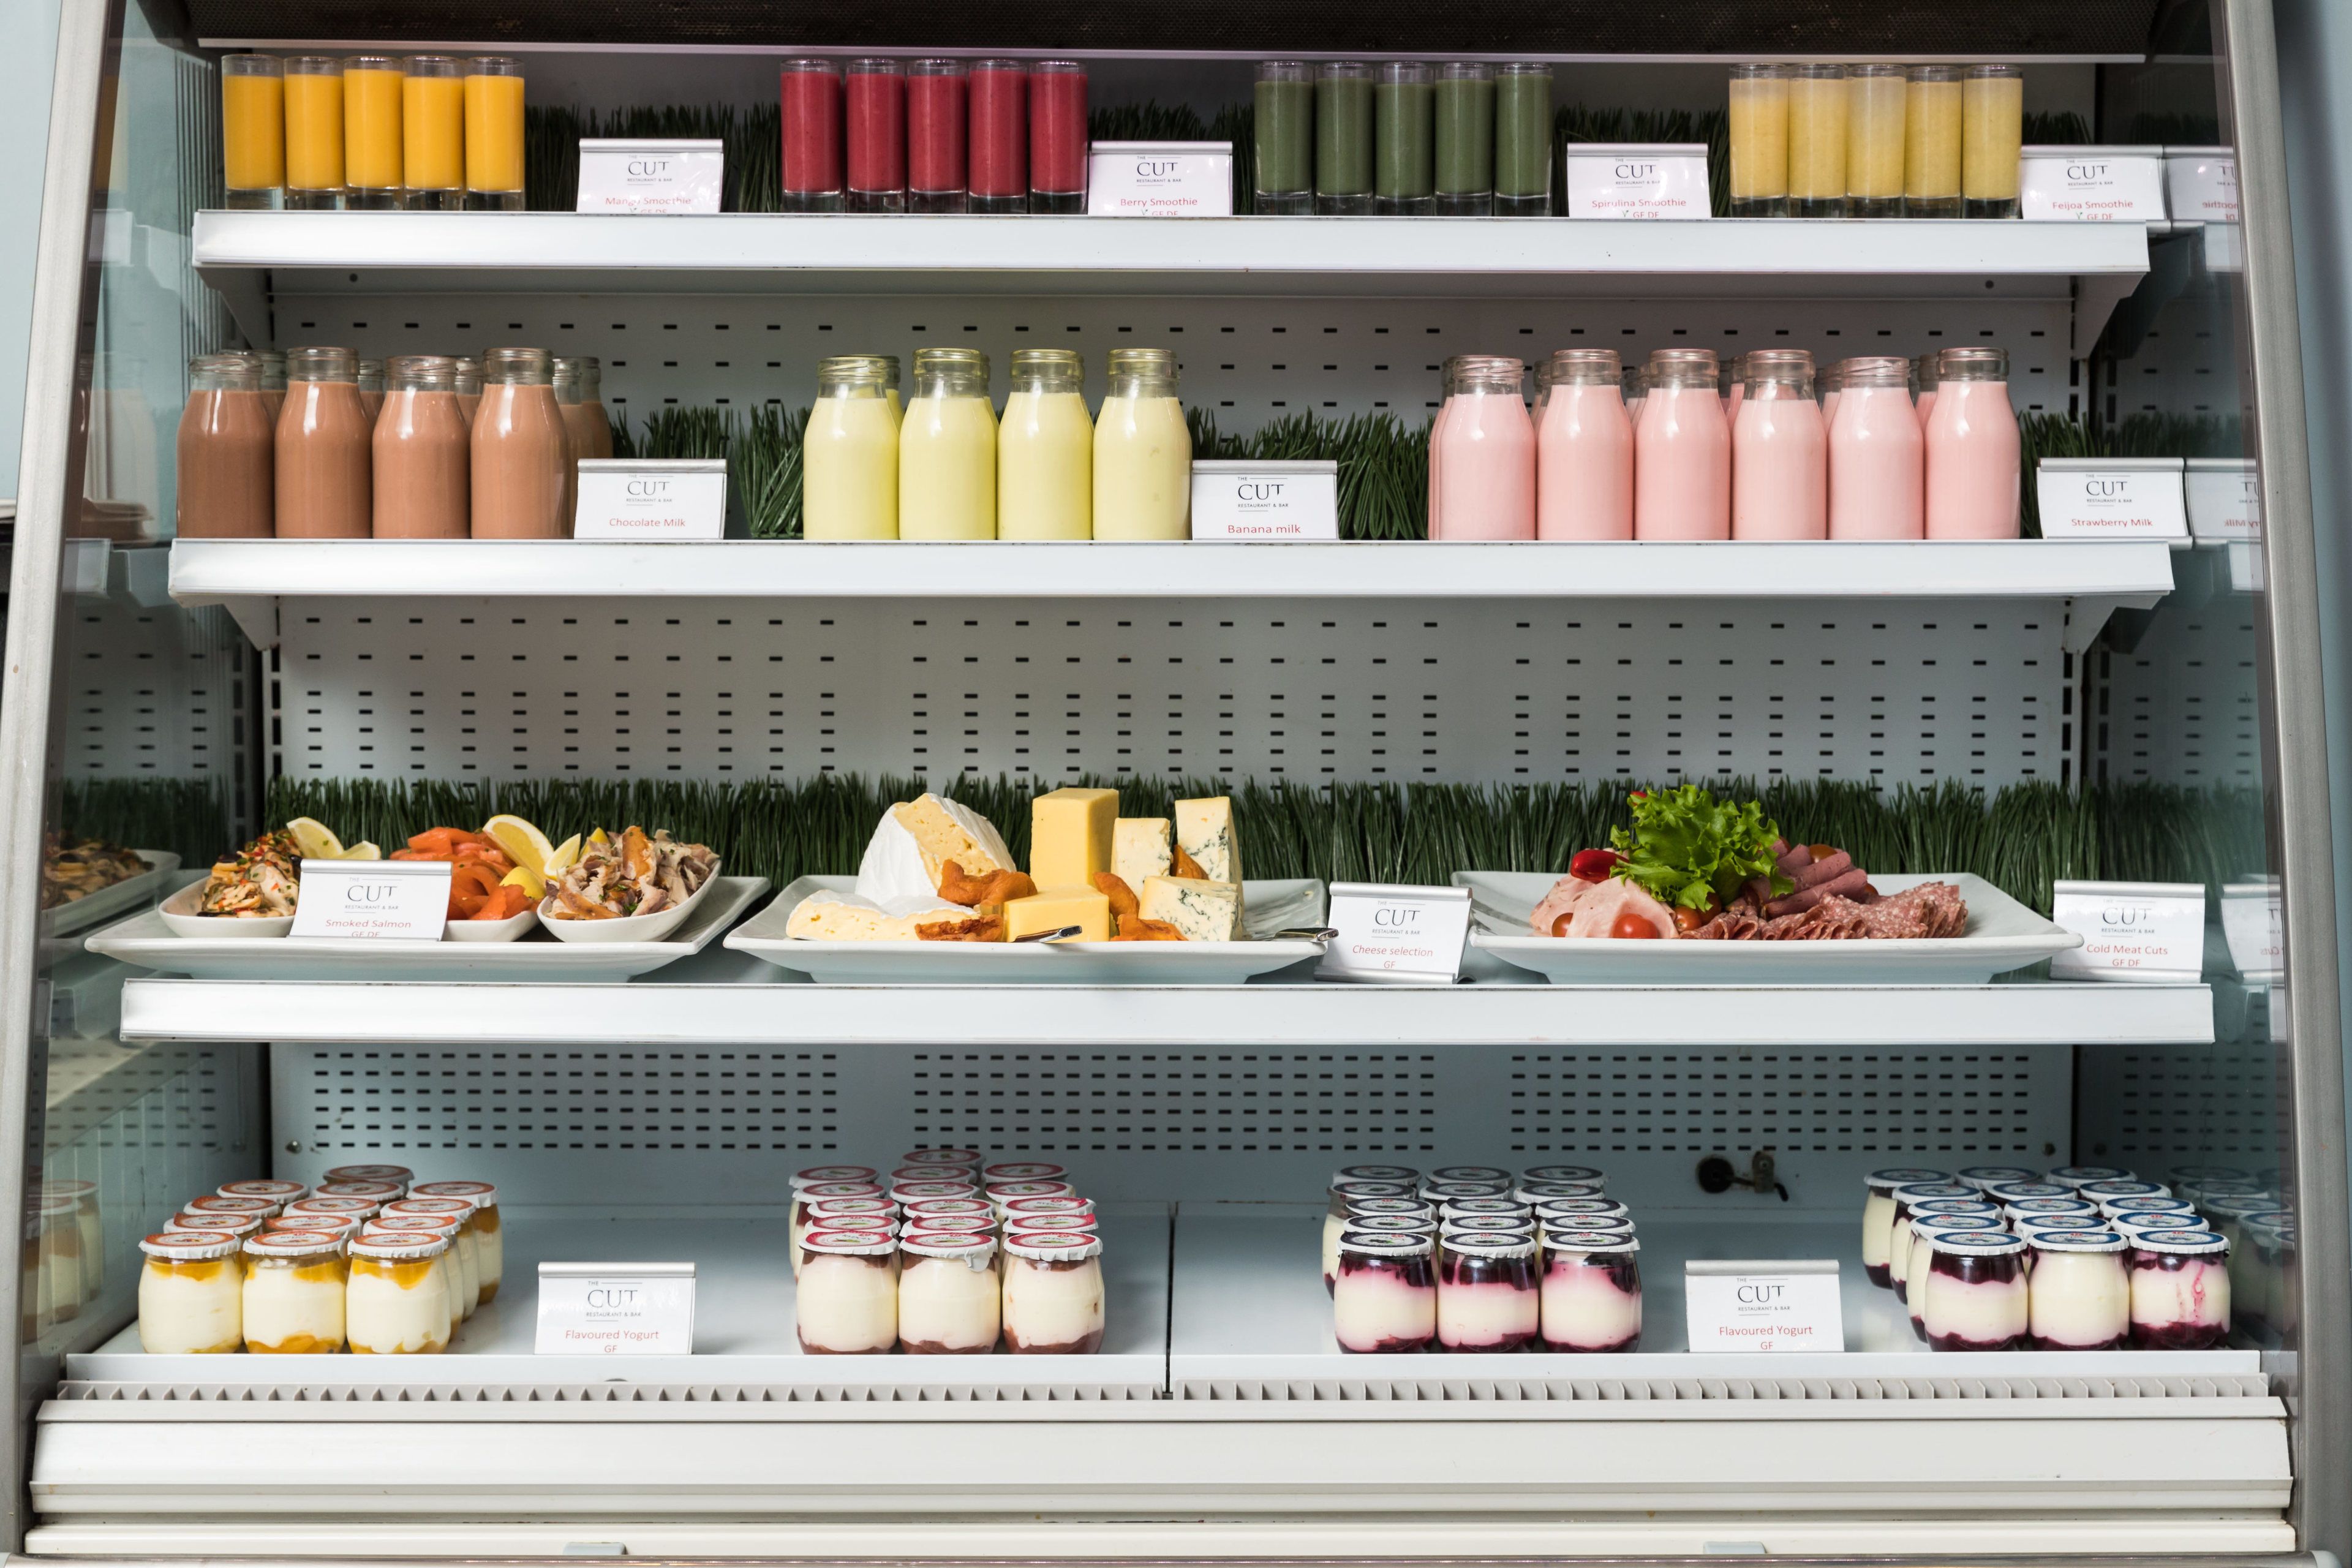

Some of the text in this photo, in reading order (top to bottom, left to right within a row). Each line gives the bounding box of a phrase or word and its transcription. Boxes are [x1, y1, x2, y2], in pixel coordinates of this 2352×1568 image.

[628, 162, 669, 175] CUT
[1137, 162, 1178, 176] CUT
[1616, 165, 1656, 178] CUT
[2067, 165, 2108, 179] CUT
[1592, 200, 1635, 209] Spirulina
[2052, 202, 2082, 210] Feijoa
[627, 481, 670, 496] CUT
[1238, 484, 1284, 500] CUT
[2087, 481, 2127, 496] CUT
[2071, 519, 2127, 527] Strawberry
[348, 886, 397, 902] CUT
[1375, 909, 1420, 925] CUT
[2102, 908, 2152, 925] CUT
[1353, 945, 1433, 957] Cheese selection
[2087, 944, 2168, 954] Cold Meat Cuts
[588, 1290, 638, 1308] CUT
[1738, 1286, 1785, 1302] CUT
[565, 1330, 659, 1341] Flavoured Yogurt
[1719, 1326, 1813, 1336] Flavoured Yogurt
[1761, 1341, 1773, 1350] GF
